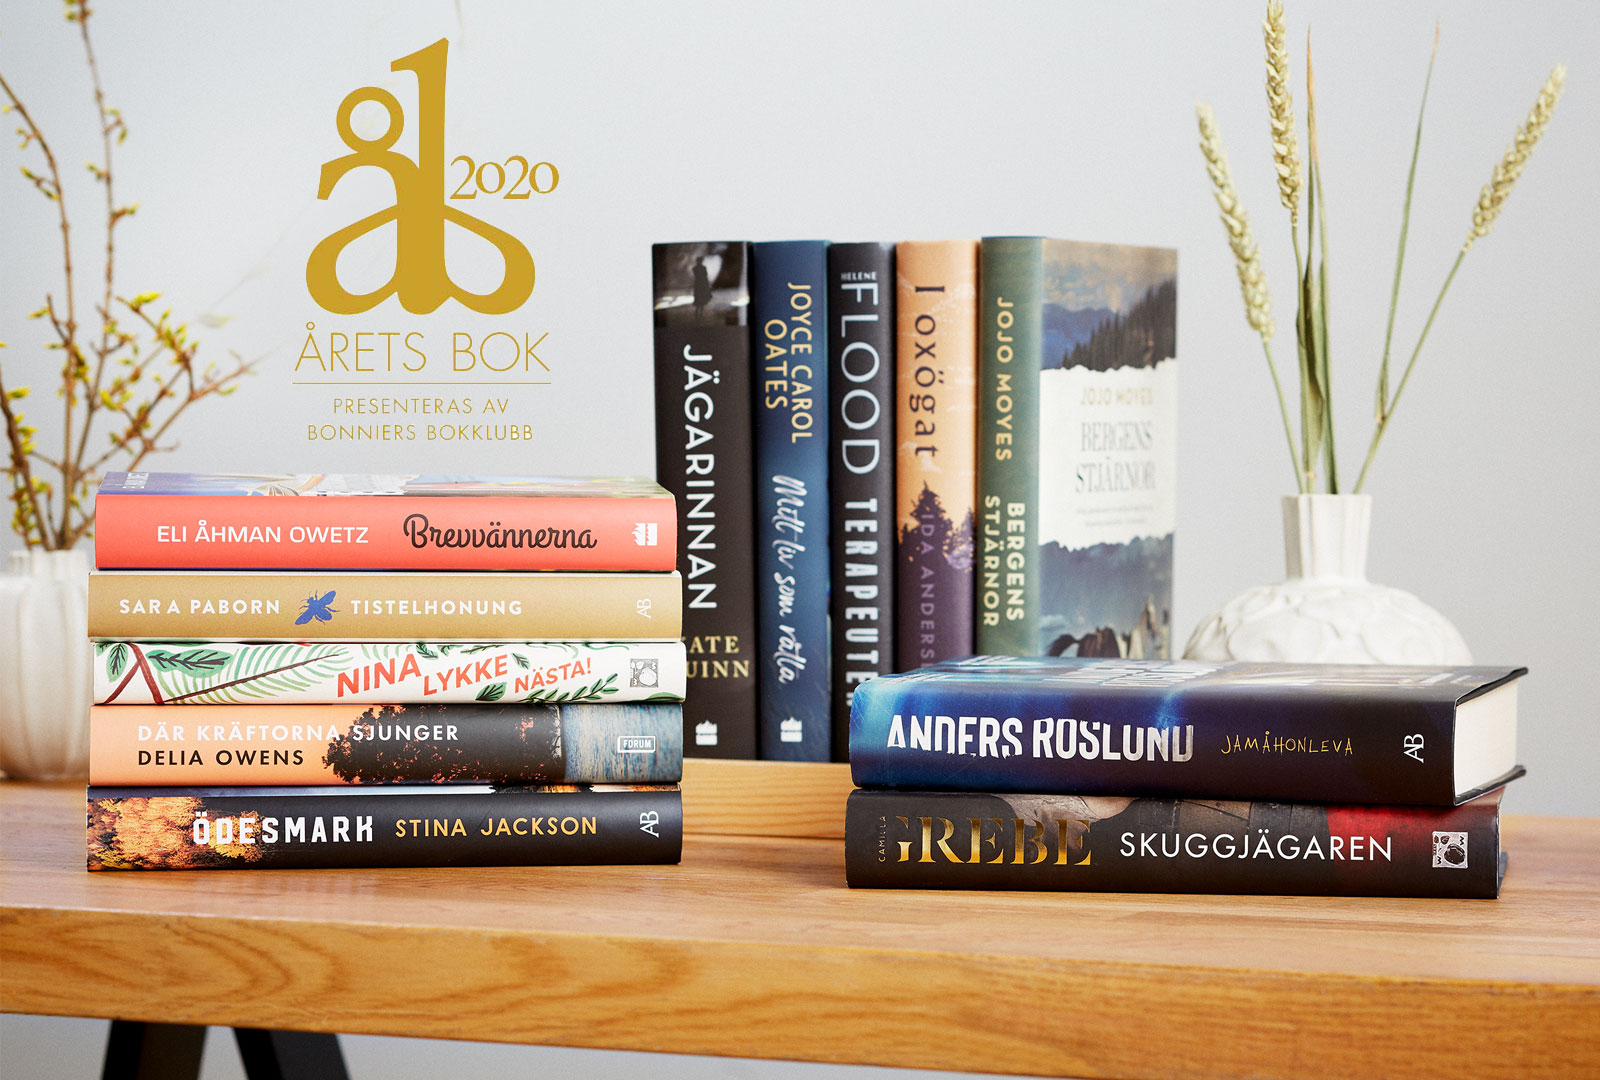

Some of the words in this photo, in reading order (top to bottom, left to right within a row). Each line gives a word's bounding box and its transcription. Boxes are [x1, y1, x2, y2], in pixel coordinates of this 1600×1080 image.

[841, 271, 877, 281] HELENE
[787, 282, 812, 356] JOYCE
[996, 297, 1014, 364] JOJO
[764, 319, 788, 409] OATES
[841, 282, 880, 475] FLOOD
[791, 364, 813, 444] CAROL
[909, 314, 945, 458] oxögat
[995, 373, 1013, 461] MOYES
[1080, 420, 1153, 452] BERGENS
[683, 344, 720, 609] JÄGARINNAN
[157, 526, 187, 543] ELI
[195, 520, 281, 543] ÅHMAN
[290, 526, 369, 544] OWETZ
[403, 513, 597, 549] Brevvännerna
[920, 514, 935, 555] IDA
[983, 495, 1005, 627] STJÄRNOR
[1006, 502, 1026, 621] BERGENS
[119, 599, 181, 614] SARA
[190, 599, 280, 614] PABORN
[351, 600, 523, 615] TISTELHONUNG
[637, 598, 651, 619] AB
[774, 572, 796, 618] som
[845, 498, 879, 706] TERAPEUTE
[920, 566, 935, 668] ANDERS
[682, 635, 739, 654] ATE
[337, 653, 422, 698] NINA
[423, 654, 509, 696] LYKKE
[514, 657, 592, 694] NÄSTA!
[138, 722, 185, 742] DÄR
[197, 721, 341, 742] KRÄFTORNA
[352, 724, 459, 741] SJUNGER
[623, 739, 651, 748] FORUM
[887, 714, 1023, 760] ANDERS
[1032, 717, 1194, 762] ROSLUND
[1221, 730, 1353, 756] JAMÅHONLEVA
[1403, 733, 1424, 763] AB
[138, 750, 204, 766] DELIA
[215, 749, 304, 766] OWENS
[193, 811, 374, 845] ÖDESMARK
[395, 818, 467, 838] STINA
[480, 816, 597, 838] JACKSON
[639, 810, 659, 838] AB
[878, 815, 886, 863] CAMILLA
[1119, 829, 1392, 862] SKUGGJÄGAREN
